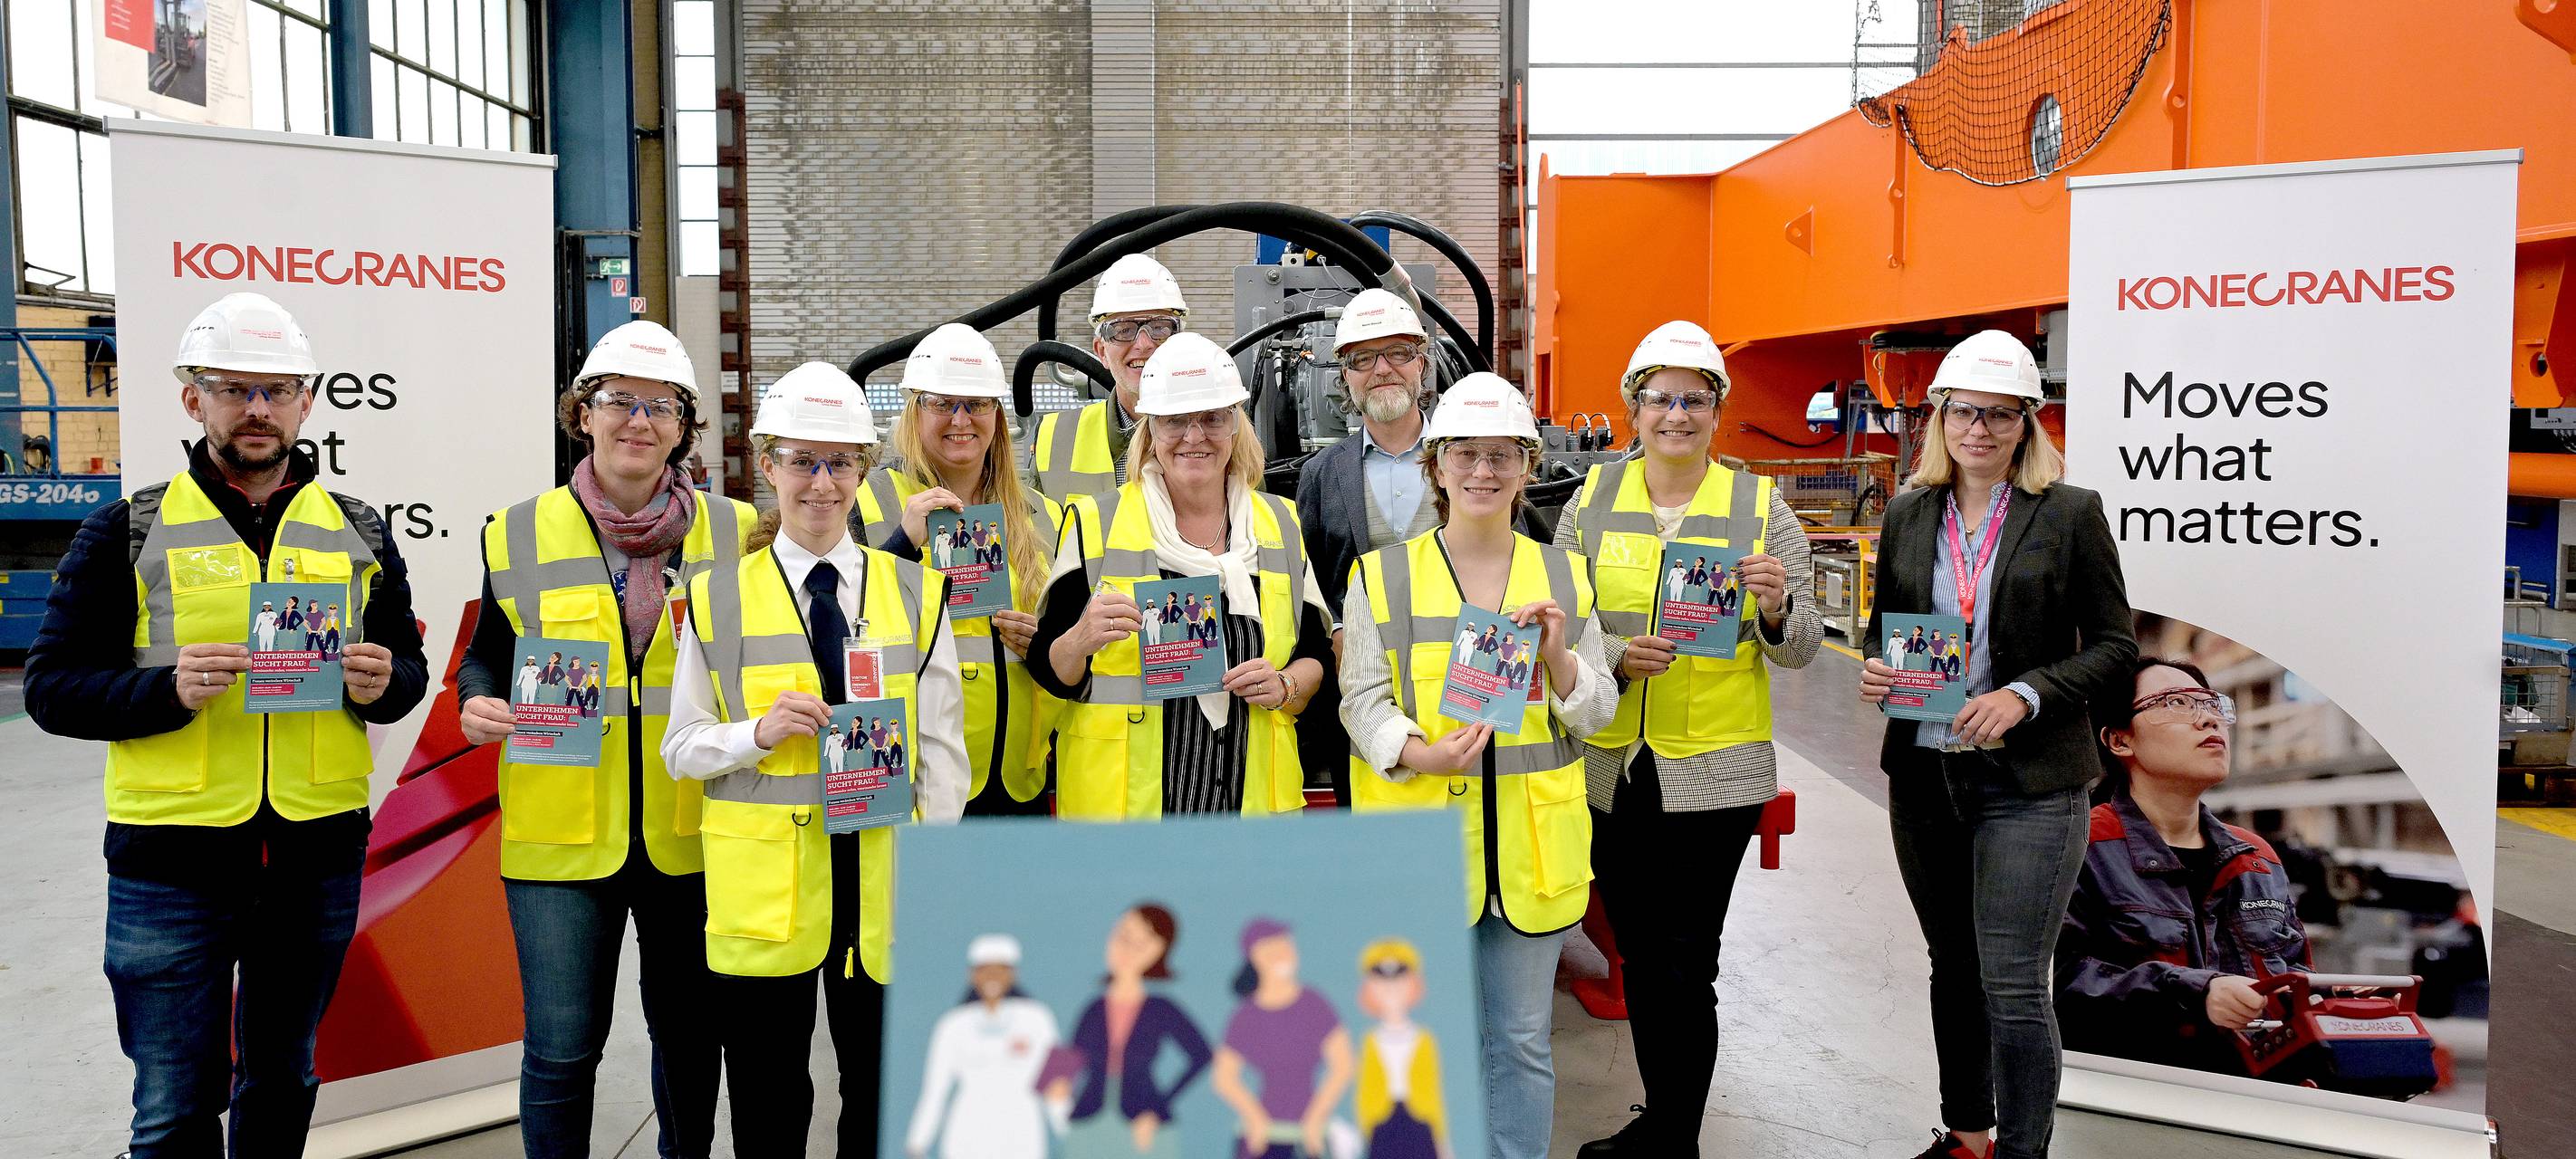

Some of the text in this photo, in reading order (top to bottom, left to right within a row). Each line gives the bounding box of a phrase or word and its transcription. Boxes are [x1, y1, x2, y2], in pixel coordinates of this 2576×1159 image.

[173, 241, 506, 293] KONECRANES
[2118, 265, 2456, 311] KONECRANES
[2123, 371, 2329, 419] Moves
[2118, 433, 2273, 482] what
[2119, 501, 2379, 547] matters.
[940, 565, 987, 575] NTERNEHMEN
[1664, 608, 1707, 618] SUCHT FRAU:
[1665, 601, 1718, 613] UNTERNEHMEN
[1144, 641, 1201, 653] UNTERNEHMEN
[254, 652, 319, 660] UNTERNEHMEN
[1145, 651, 1169, 660] SUCHT
[1451, 670, 1474, 683] SUCHT
[1453, 663, 1506, 685] UNTERNEHMEN
[516, 704, 579, 714] UNTERNEHMEN
[827, 769, 886, 781] UNTERNEHMEN
[827, 778, 876, 790] SUCHT FRAU:
